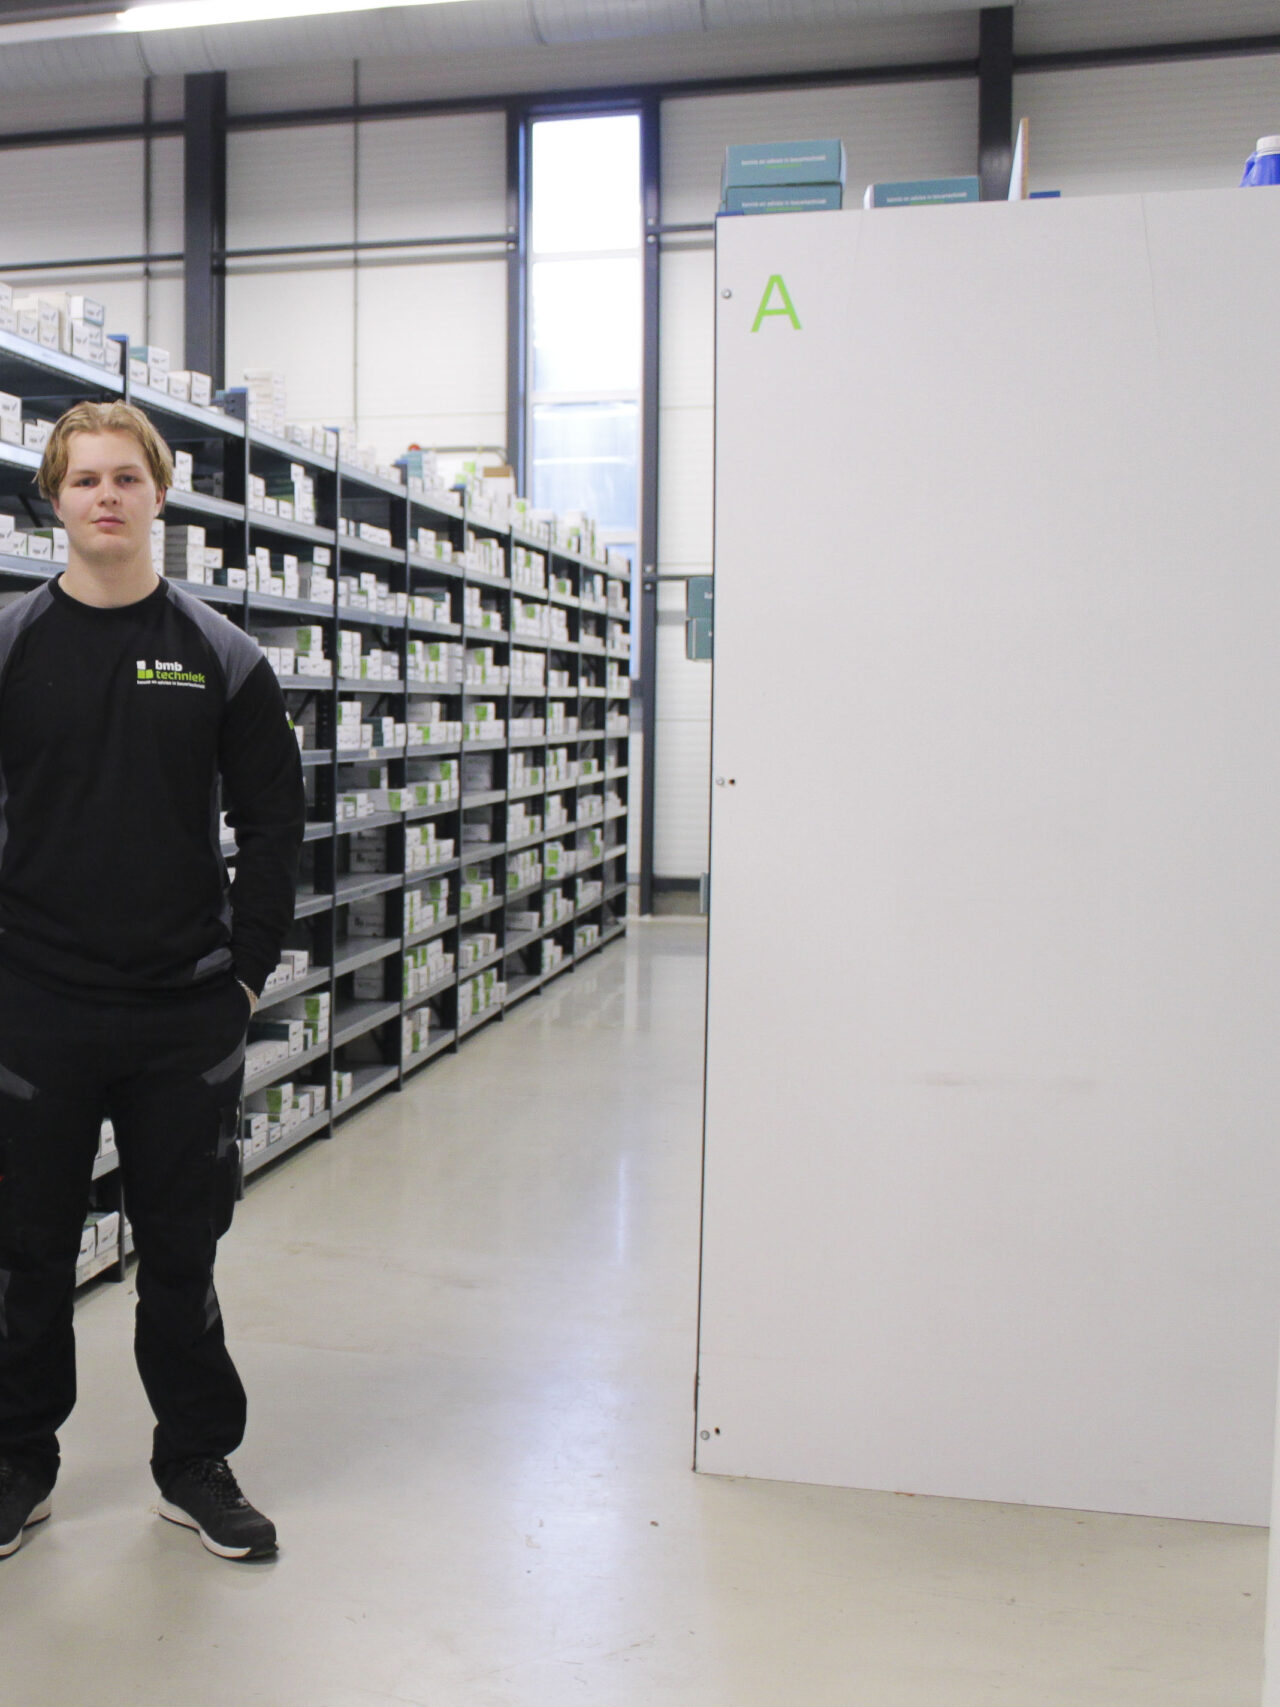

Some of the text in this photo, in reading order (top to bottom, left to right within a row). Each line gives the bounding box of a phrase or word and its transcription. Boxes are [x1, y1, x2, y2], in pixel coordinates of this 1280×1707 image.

[750, 274, 803, 333] A
[155, 660, 183, 671] bmb
[155, 671, 206, 683] techniek
